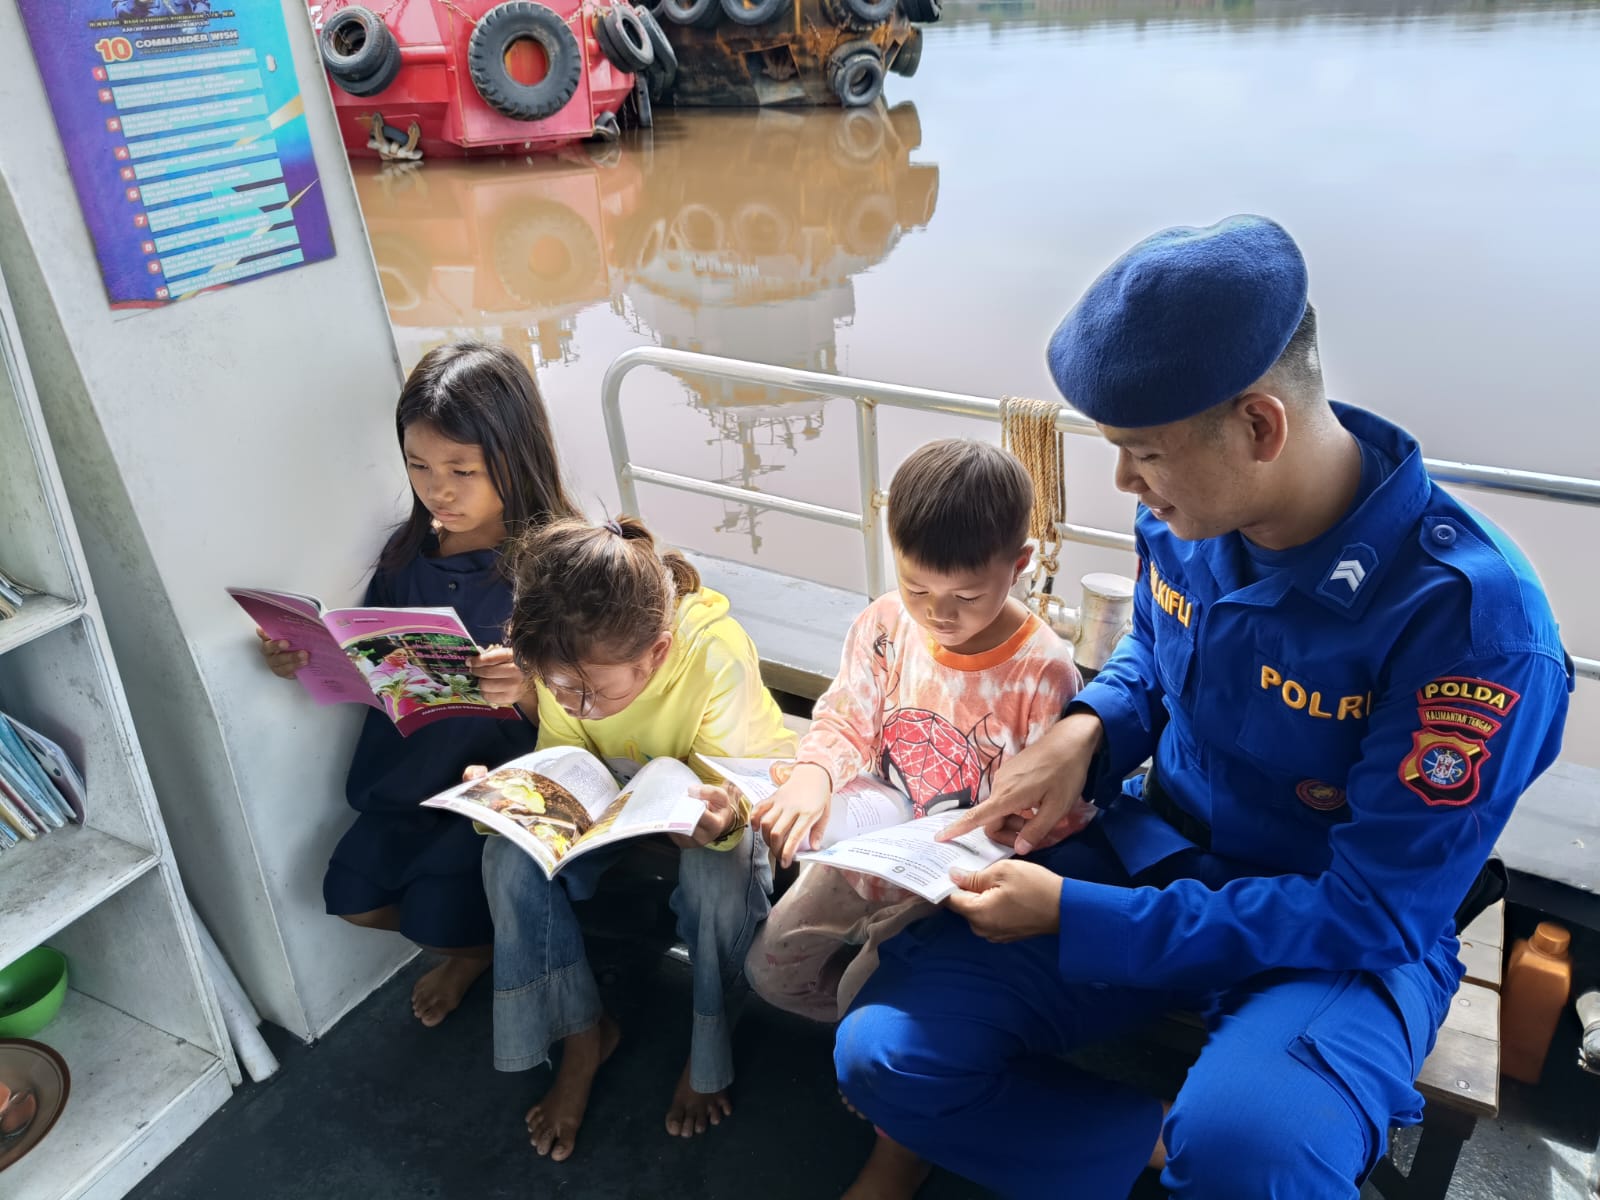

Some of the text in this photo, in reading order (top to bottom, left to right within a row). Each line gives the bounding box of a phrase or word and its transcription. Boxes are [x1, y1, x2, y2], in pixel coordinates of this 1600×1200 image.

[95, 37, 133, 62] 10
[135, 33, 209, 48] COMMANDER
[210, 30, 239, 41] WISH
[1424, 682, 1506, 709] POLDA
[1425, 711, 1493, 733] KALIMANTAN TENGAH
